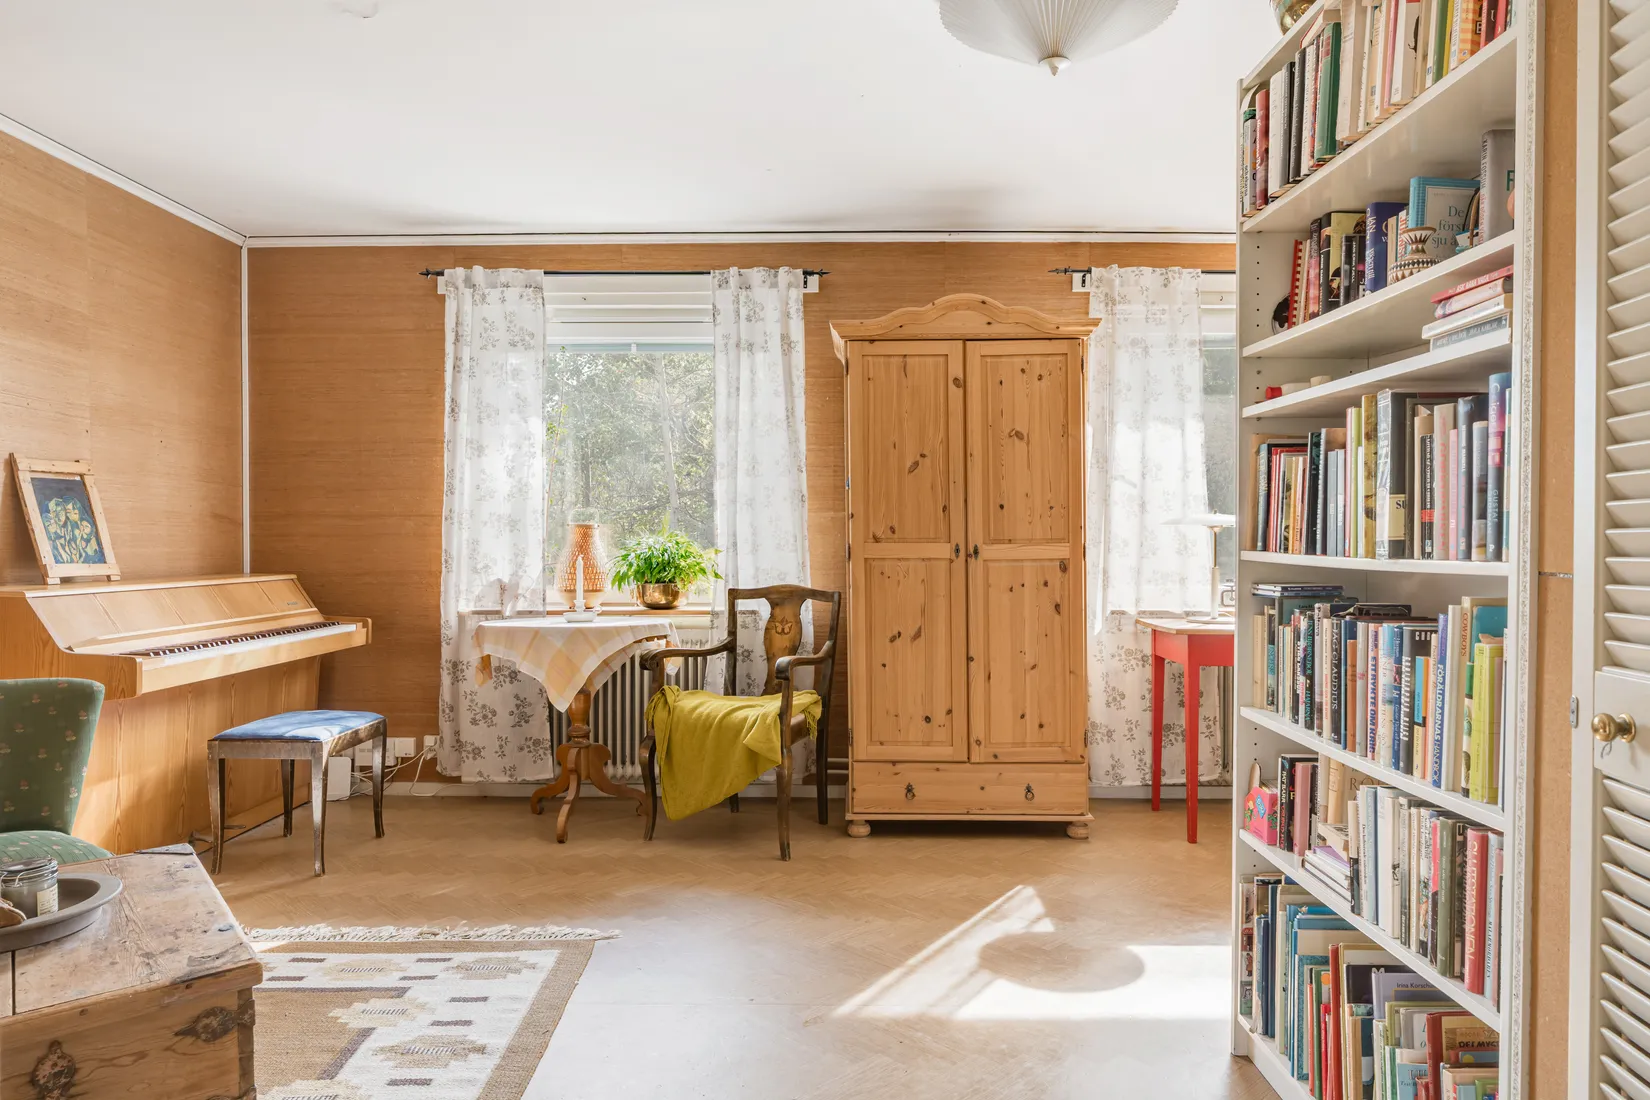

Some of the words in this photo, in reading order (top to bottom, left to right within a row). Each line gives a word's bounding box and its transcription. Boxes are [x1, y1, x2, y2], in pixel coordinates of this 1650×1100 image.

[1448, 205, 1465, 218] De
[1431, 233, 1447, 249] sju
[1460, 612, 1468, 656] COWBOYS
[1434, 664, 1445, 739] FÖRÄLDRARNAS
[1432, 740, 1441, 782] HANDBOK
